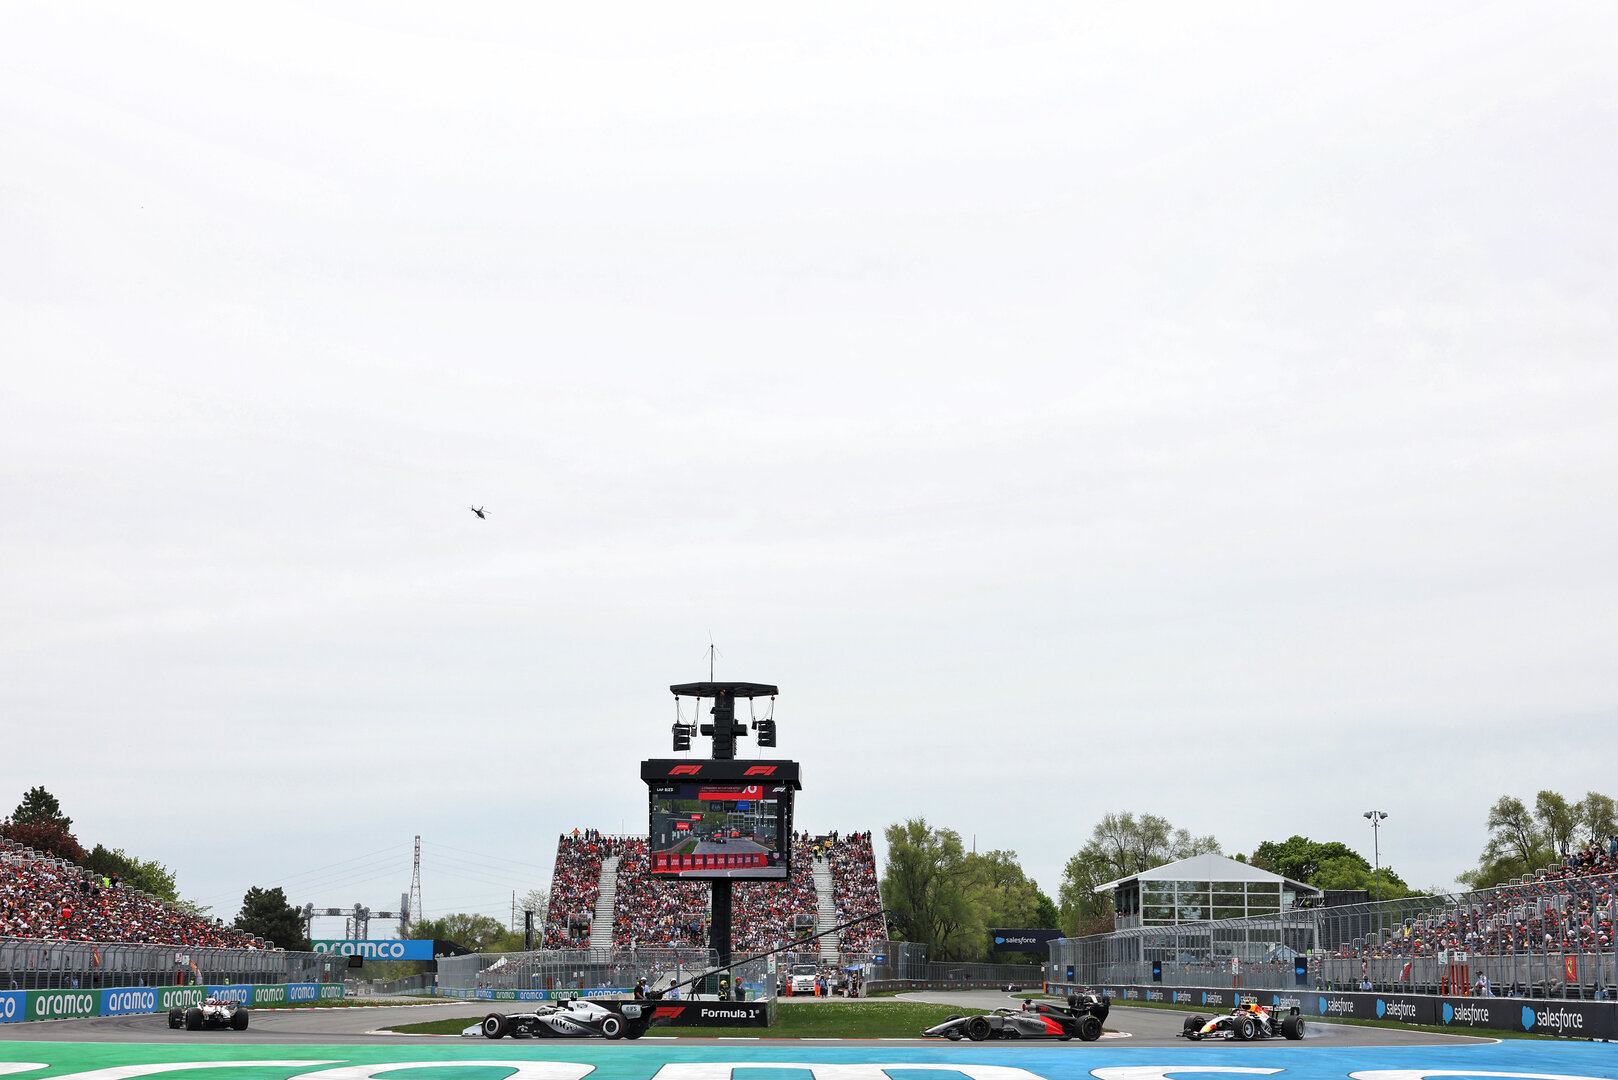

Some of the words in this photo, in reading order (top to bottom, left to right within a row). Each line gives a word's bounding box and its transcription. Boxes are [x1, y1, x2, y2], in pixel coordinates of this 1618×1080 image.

[313, 942, 405, 958] aramco
[163, 989, 202, 1008] aramco
[255, 987, 284, 1002] aramco
[290, 986, 315, 999] aramco
[321, 986, 341, 998] aramco
[496, 990, 516, 999] aramco
[520, 990, 544, 1000] aramco
[550, 990, 579, 999] aramco
[36, 994, 93, 1015] aramco
[109, 992, 155, 1011] aramco
[1327, 997, 1354, 1016] salesforce
[701, 1009, 746, 1018] Formula
[1386, 1000, 1416, 1020] salesforce
[1454, 1003, 1489, 1026] salesforce
[1536, 1007, 1583, 1033] salesforce
